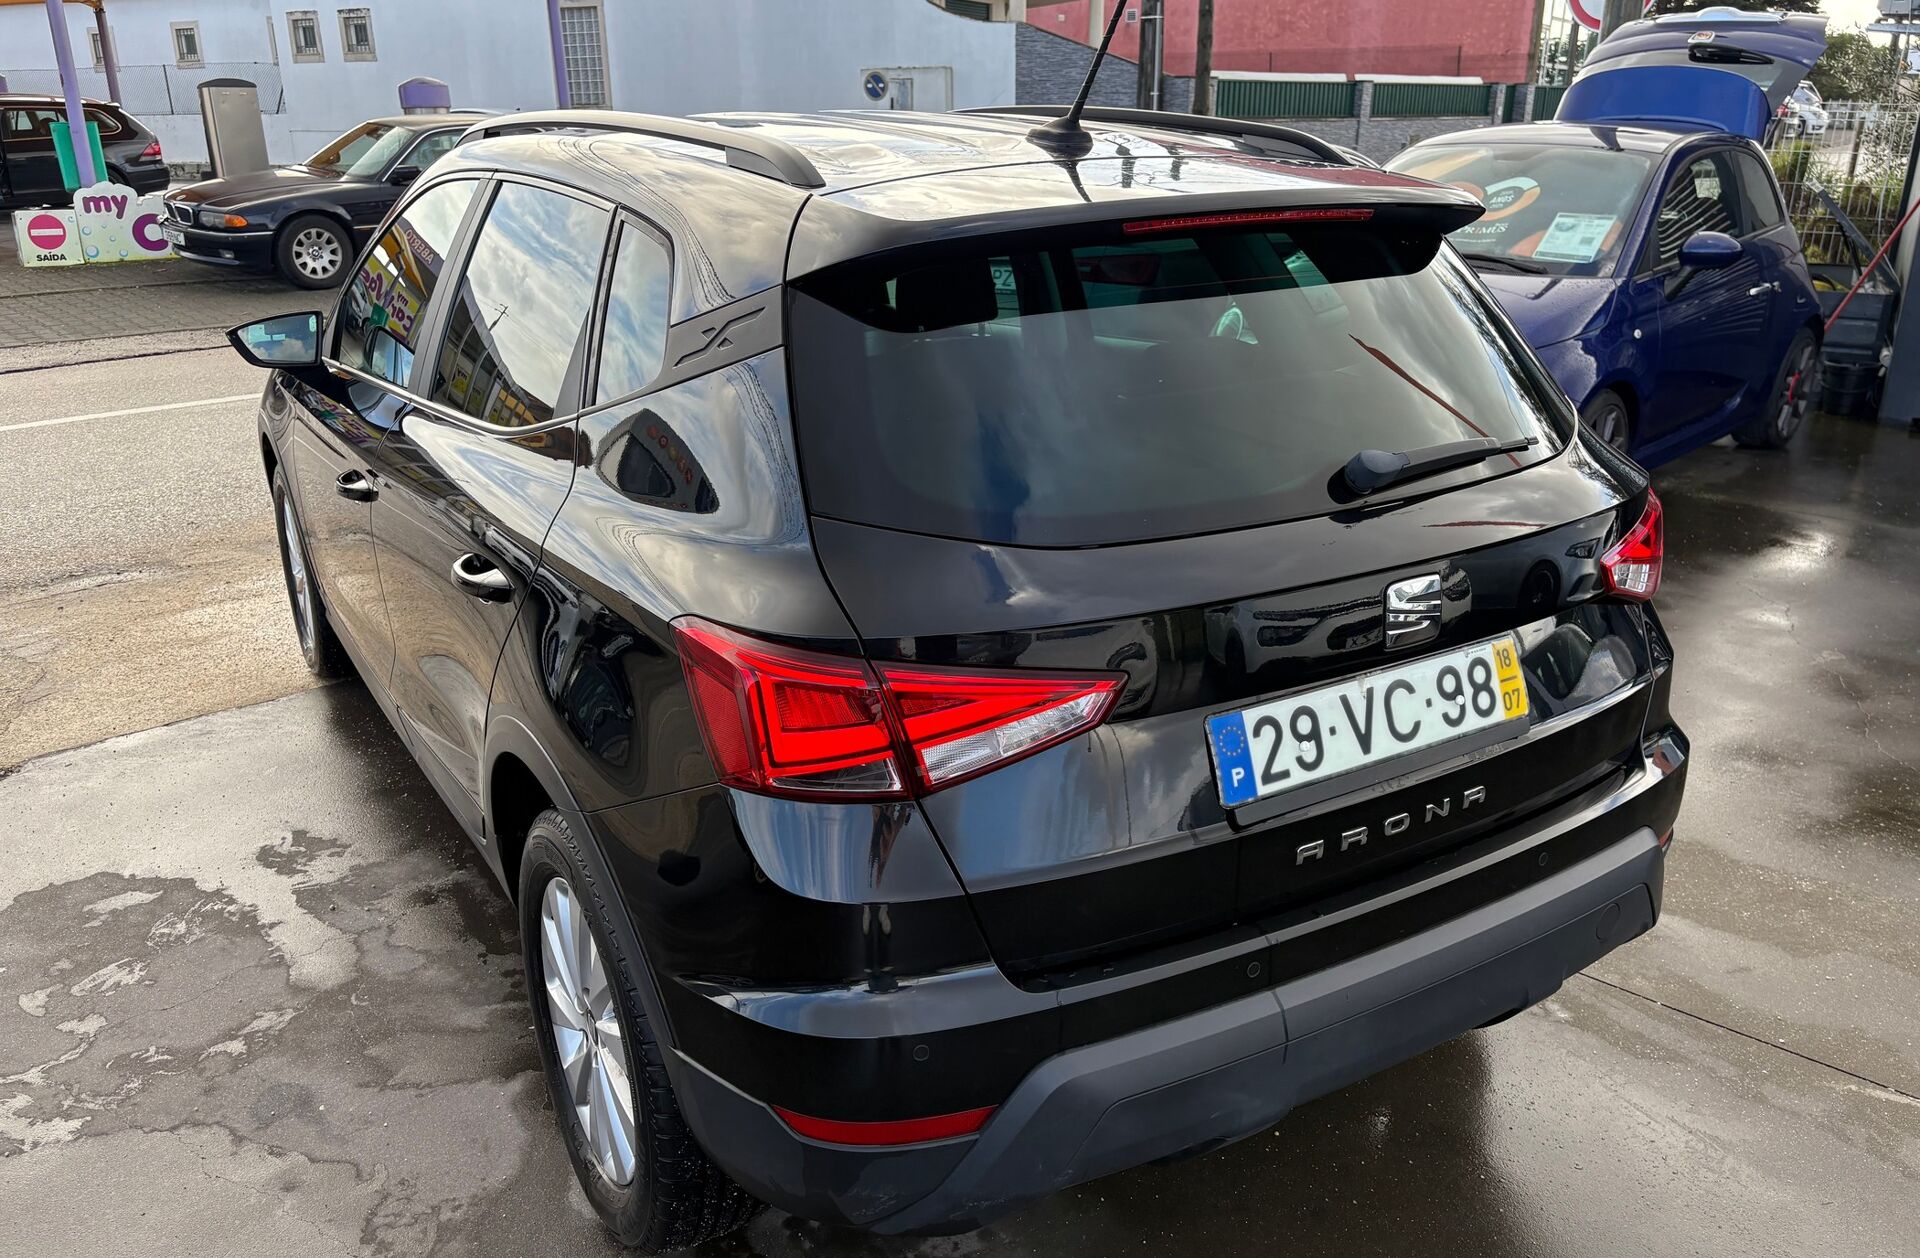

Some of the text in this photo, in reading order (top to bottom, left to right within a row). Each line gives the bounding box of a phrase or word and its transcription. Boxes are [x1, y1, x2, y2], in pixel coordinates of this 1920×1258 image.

[82, 194, 128, 219] my
[36, 251, 67, 262] SAÍDA
[1496, 648, 1512, 670] 18
[1503, 688, 1520, 712] 07
[1231, 767, 1245, 787] P
[1296, 785, 1486, 865] ARONA
